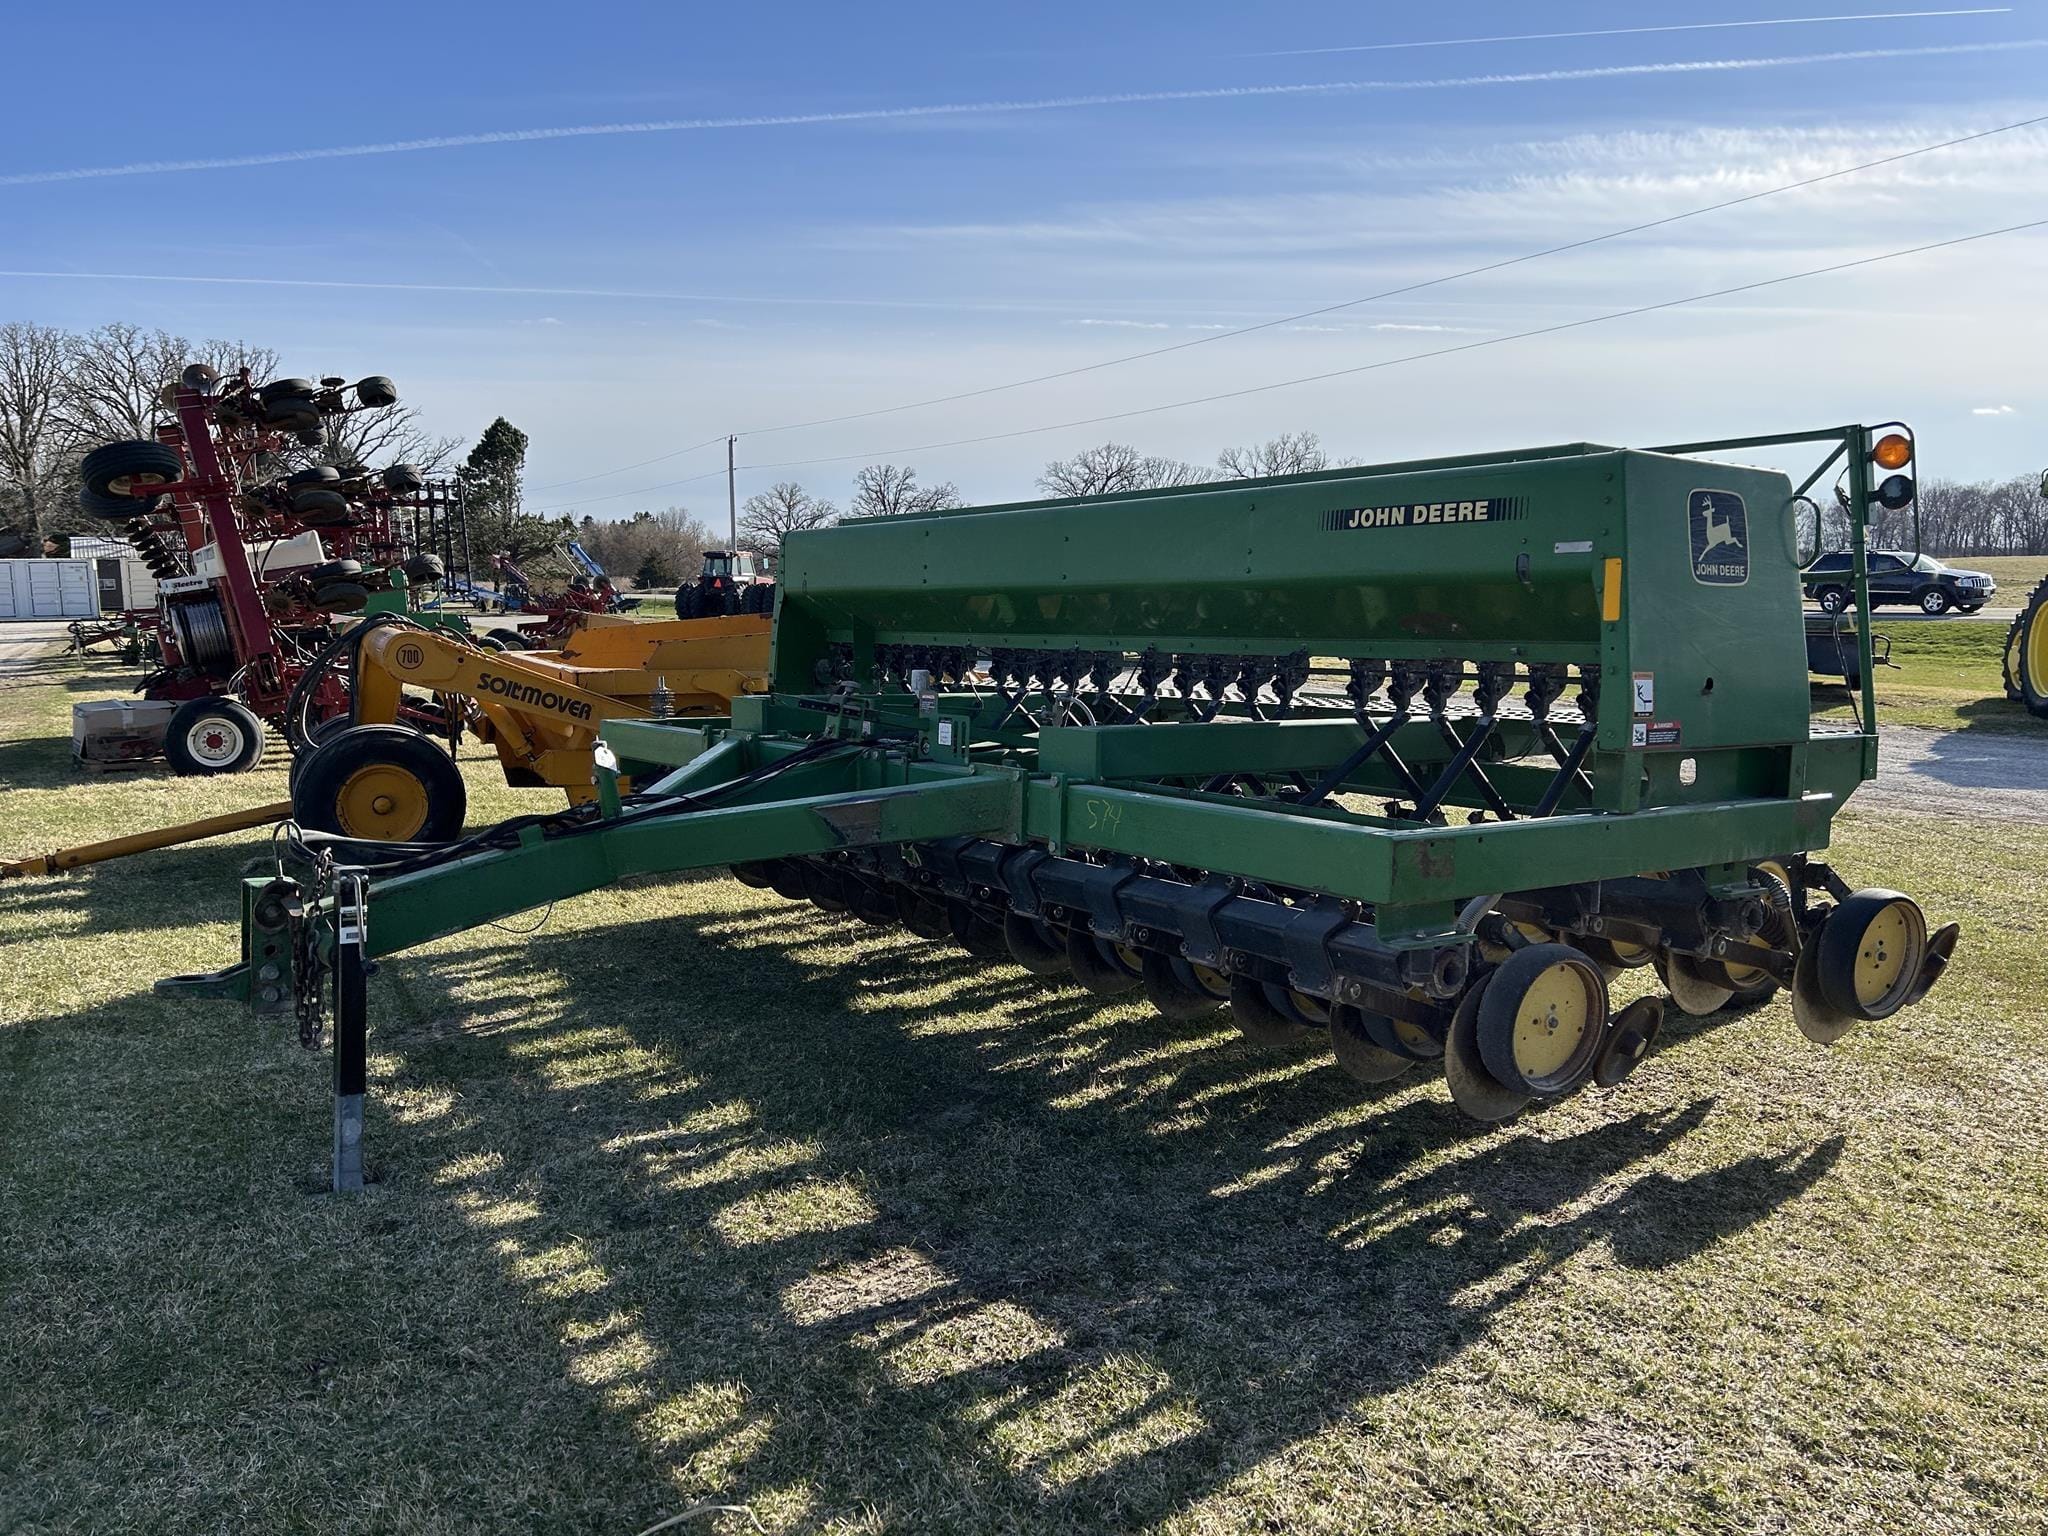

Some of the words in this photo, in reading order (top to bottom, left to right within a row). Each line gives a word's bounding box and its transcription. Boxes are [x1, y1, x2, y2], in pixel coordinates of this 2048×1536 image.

[1348, 507, 1405, 528] JOHN
[1413, 501, 1489, 524] DEERE
[1695, 564, 1718, 576] JOHN
[1719, 565, 1745, 577] DEERE
[400, 650, 419, 664] 700
